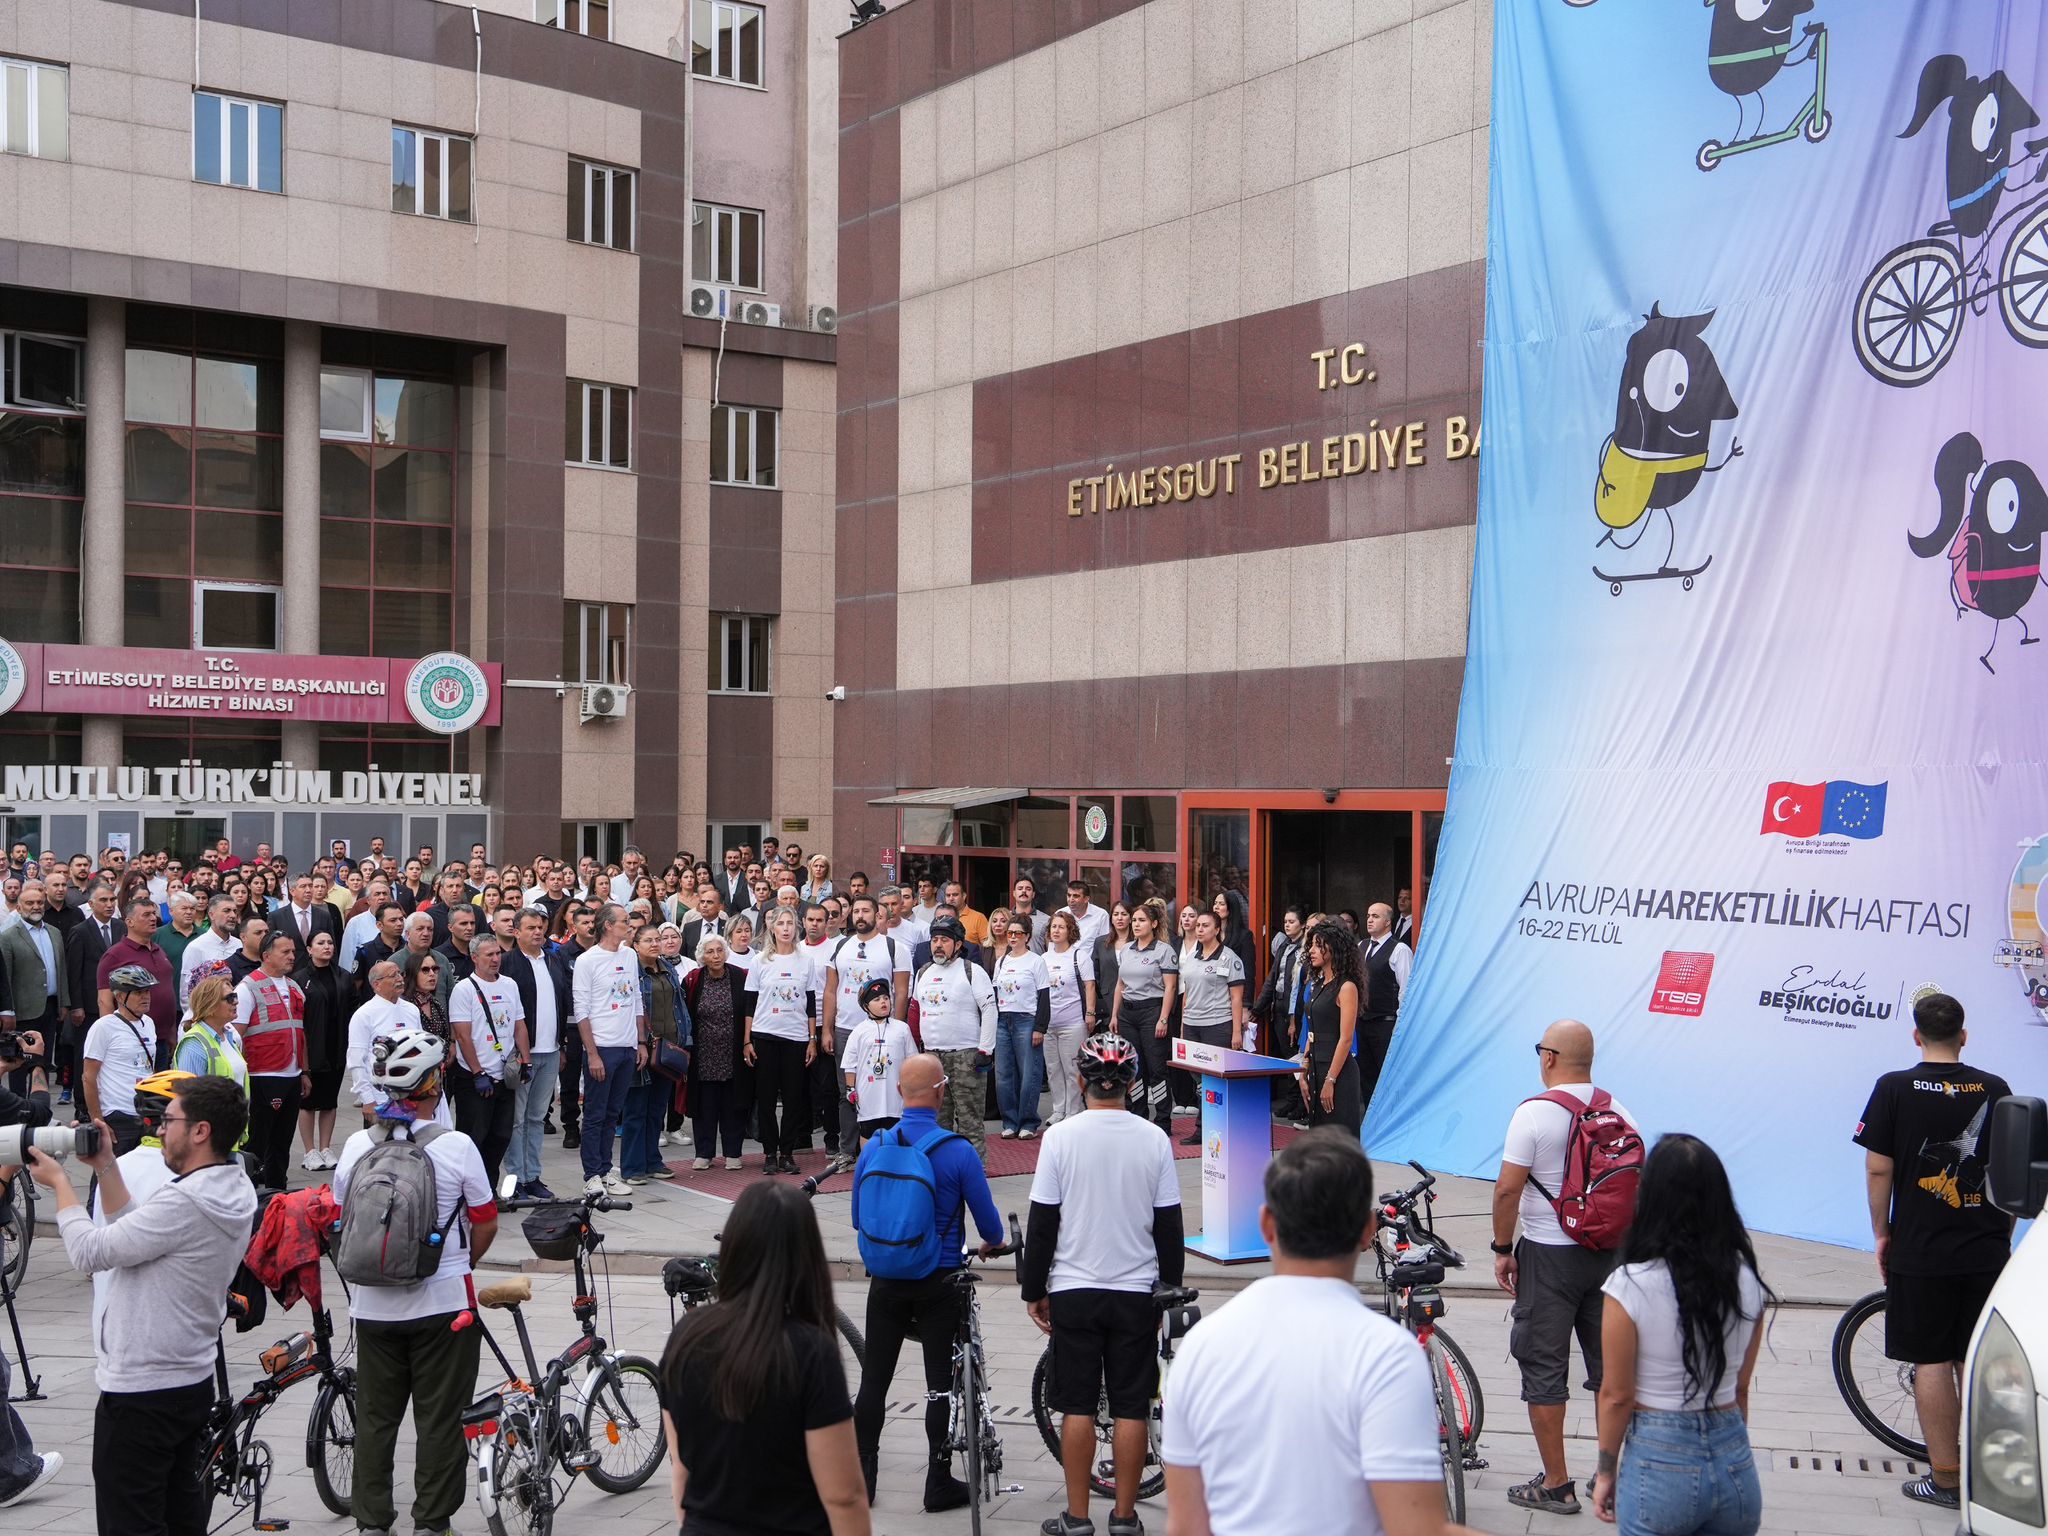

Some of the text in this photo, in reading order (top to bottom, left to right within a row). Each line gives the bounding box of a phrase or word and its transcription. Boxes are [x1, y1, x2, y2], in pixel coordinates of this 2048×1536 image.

[1310, 342, 1377, 391] T.C.
[1067, 453, 1243, 517] ETİMESGUT
[1258, 419, 1426, 491] BELEDİYE
[204, 657, 240, 672] T.C.
[48, 668, 386, 696] ETİMESGUT BELEDİYE BAŞKANLIĞI
[148, 691, 294, 712] HİZMET BİNASI
[5, 759, 482, 805] MUTLU TÜRK'ÜM DİYENE!
[1517, 917, 1623, 945] 16-22 EYLÜL
[1782, 965, 1867, 992] Erdal
[1657, 989, 1702, 1005] TBB
[1784, 1015, 1810, 1025] Etimesgut
[1811, 1018, 1834, 1029] Belediye
[1913, 1080, 1943, 1092] SOLO
[1596, 1116, 1618, 1125] Wilson
